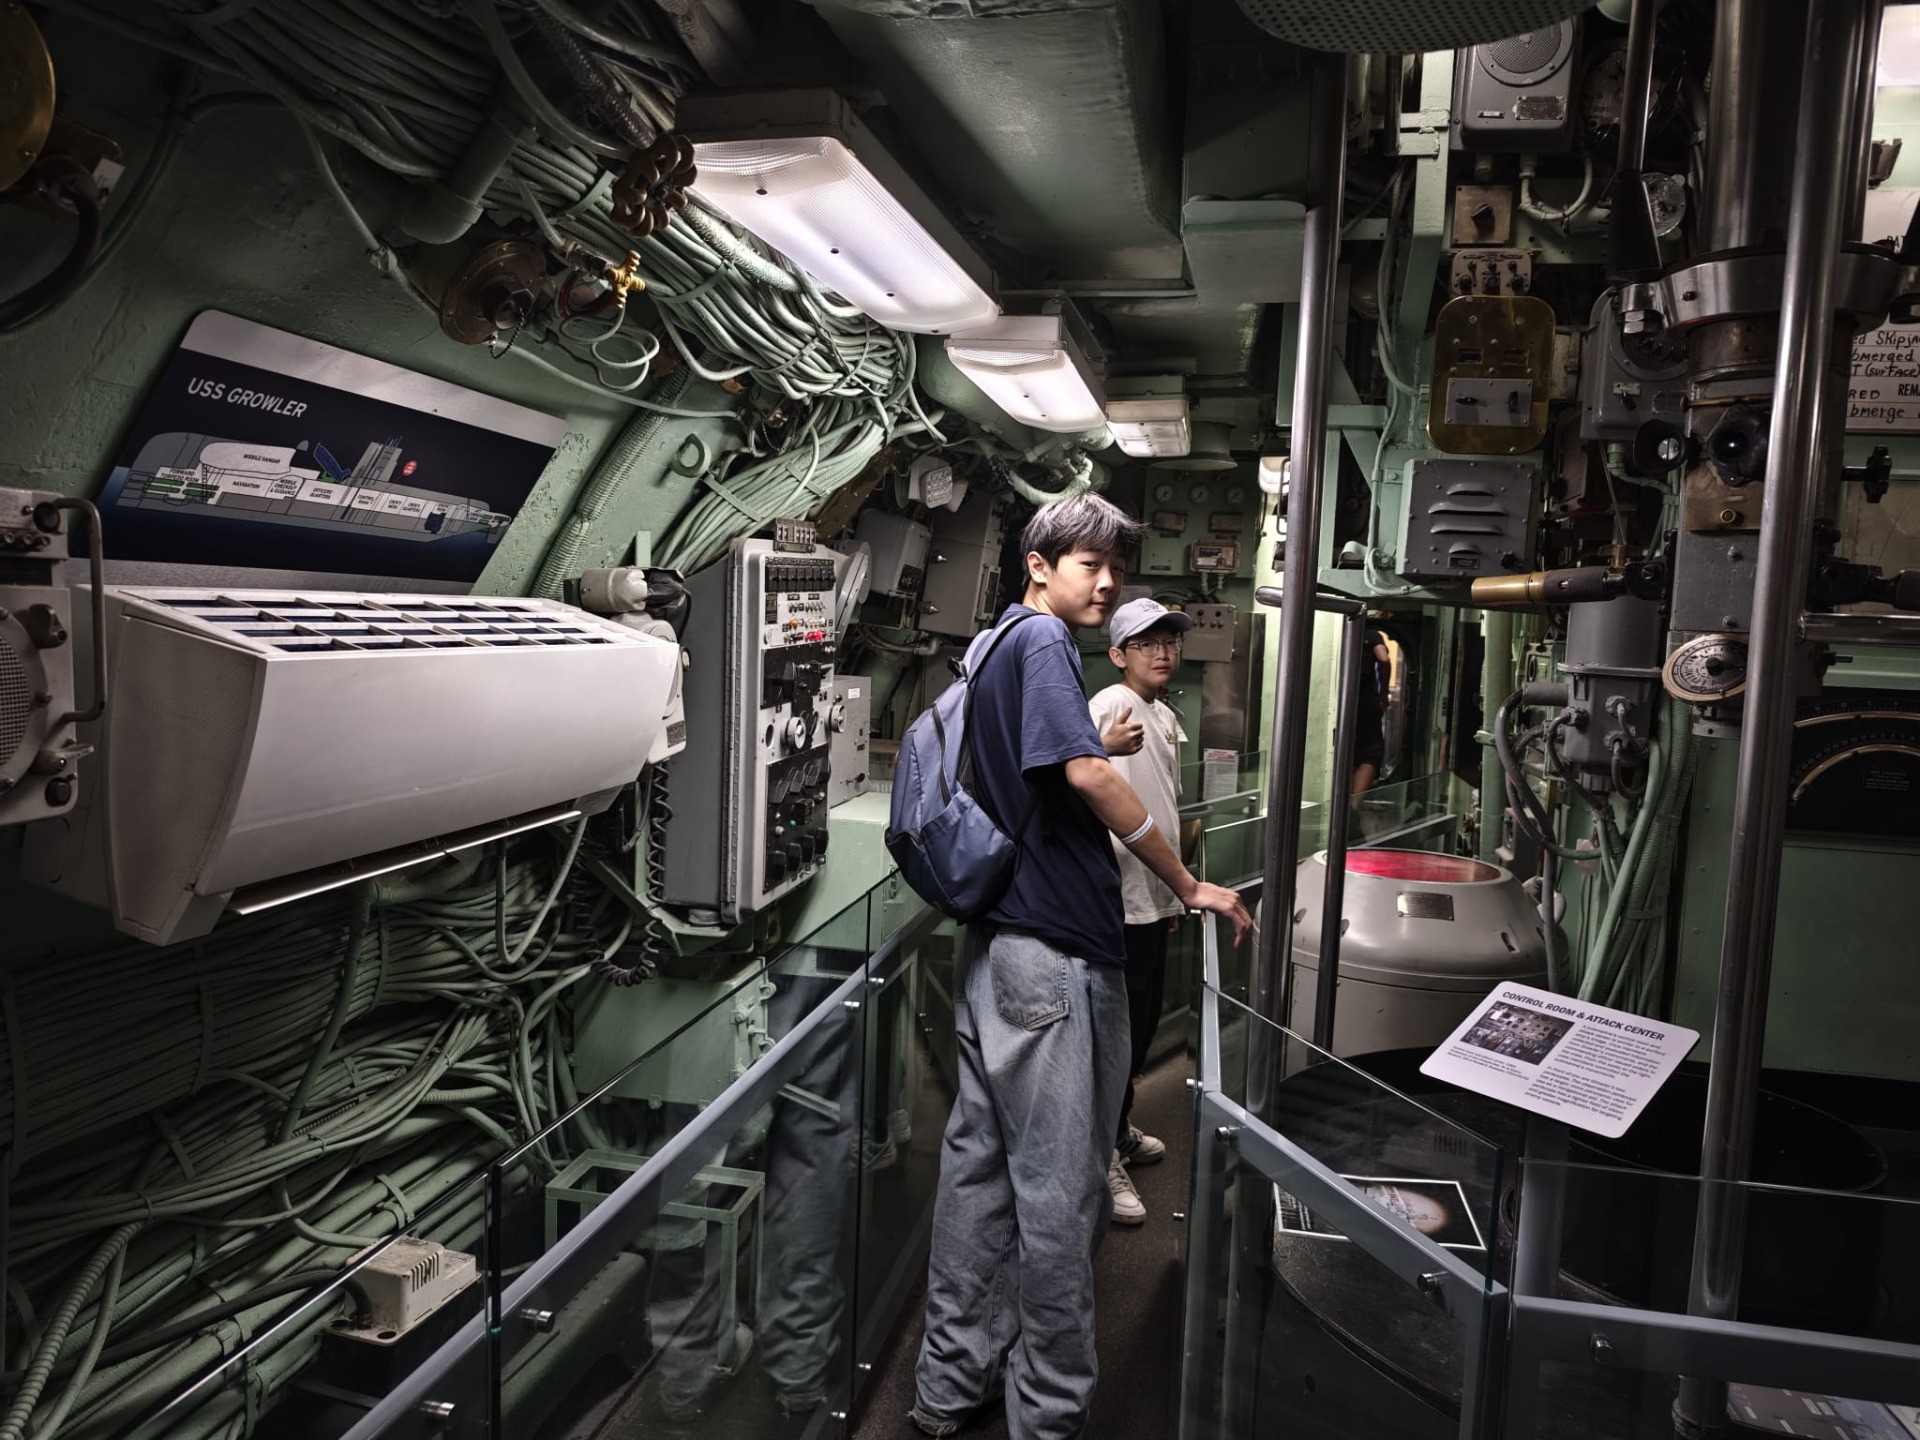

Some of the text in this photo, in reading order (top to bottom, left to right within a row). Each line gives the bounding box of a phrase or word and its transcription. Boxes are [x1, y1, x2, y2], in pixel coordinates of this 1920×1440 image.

[1852, 348, 1914, 363] bmerged
[1897, 383, 1920, 397] REM
[188, 377, 308, 418] USS GROWLER
[1850, 402, 1905, 424] bmerge
[161, 473, 199, 483] TORPEDO ROOM
[170, 468, 195, 476] FORWARD
[232, 480, 260, 489] NAVIGATION
[1502, 991, 1666, 1041] CONTROL ROOM & ATTACK CENTER
